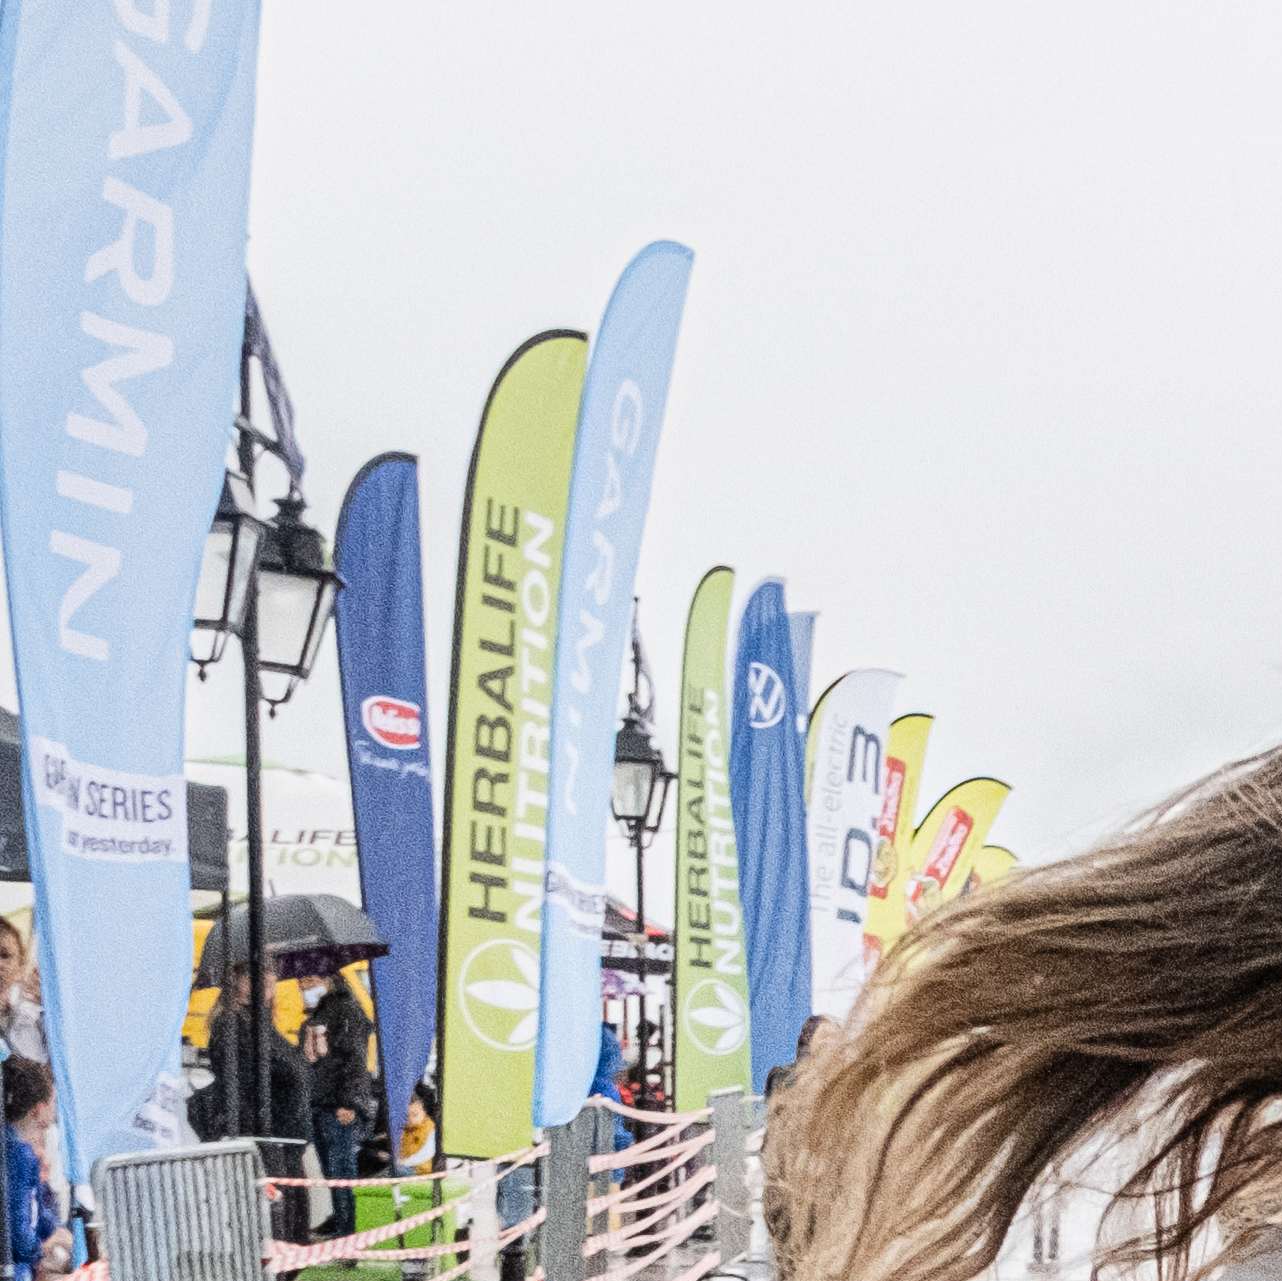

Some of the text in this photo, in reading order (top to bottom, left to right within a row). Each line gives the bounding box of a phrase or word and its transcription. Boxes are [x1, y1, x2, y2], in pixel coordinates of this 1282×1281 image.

[468, 497, 521, 923] HERBALIFE
[507, 510, 555, 935] NUTRITION
[564, 378, 643, 817] GARMIN
[85, 780, 172, 823] SERIES
[686, 685, 713, 969] HERBALIFE
[703, 689, 742, 976] NUTRITION
